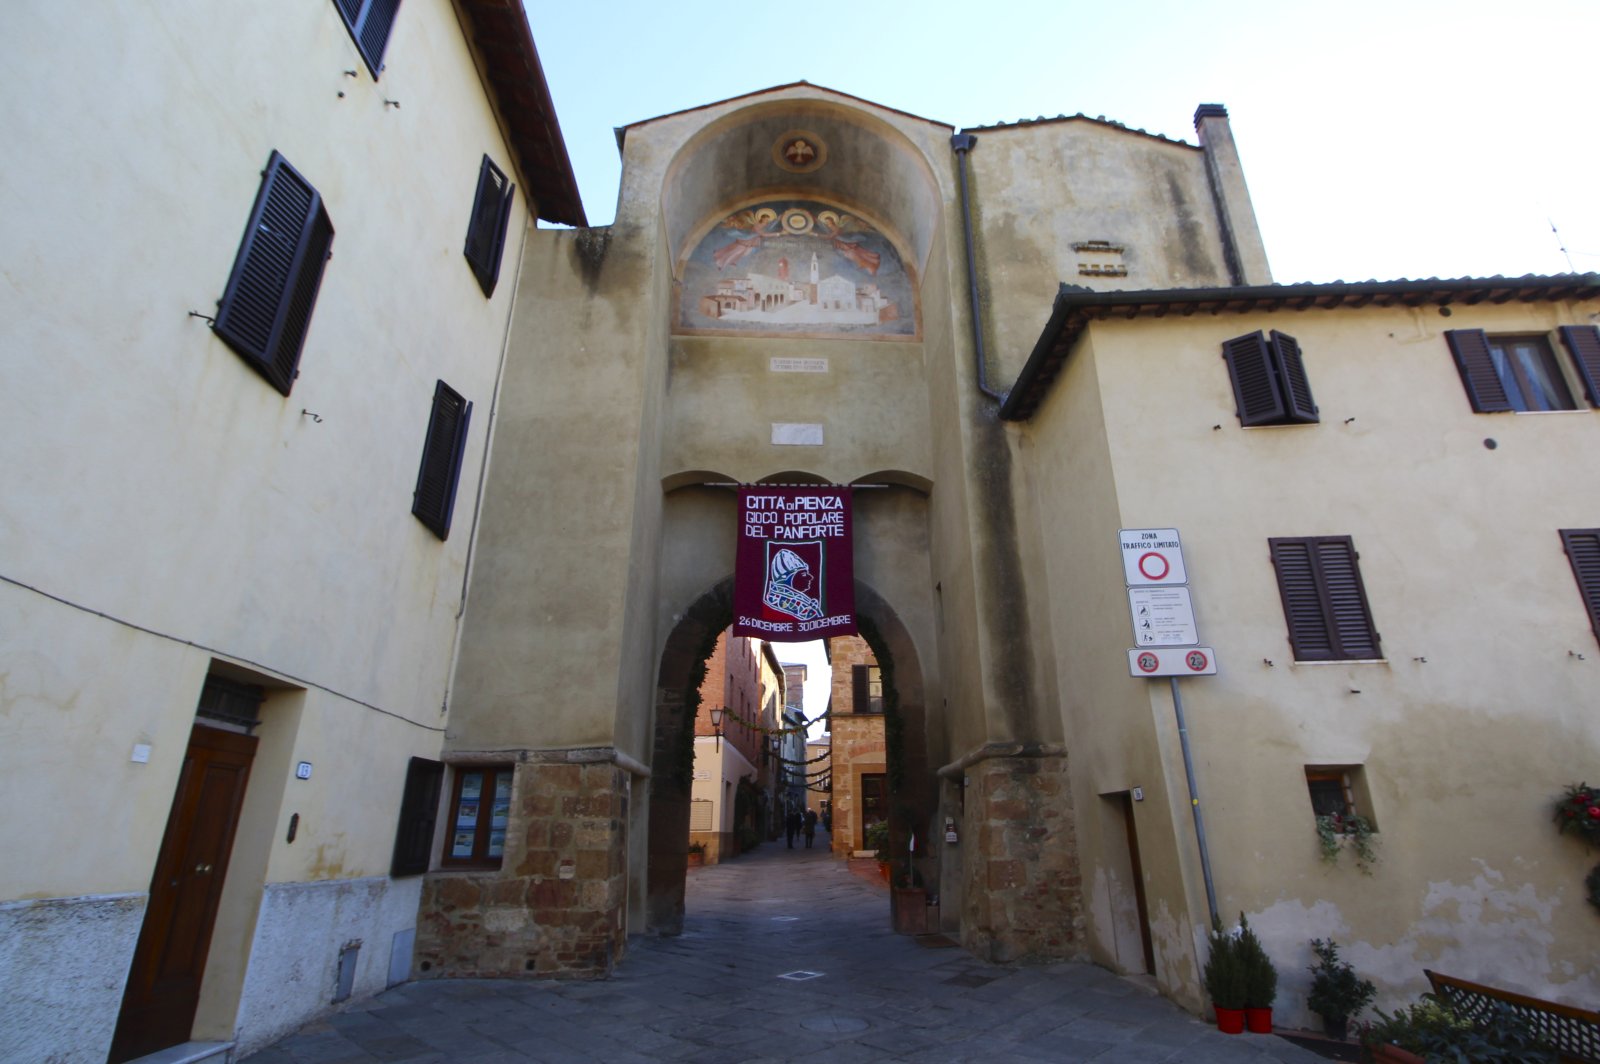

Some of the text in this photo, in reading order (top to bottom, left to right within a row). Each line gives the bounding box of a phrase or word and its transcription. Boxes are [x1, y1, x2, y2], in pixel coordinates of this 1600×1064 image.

[795, 496, 843, 510] PIENZA
[746, 511, 844, 525] GIOCO POPOLARE
[746, 524, 844, 539] DEL PANFORTE
[1141, 532, 1158, 540] ZONA
[739, 615, 751, 626] 26
